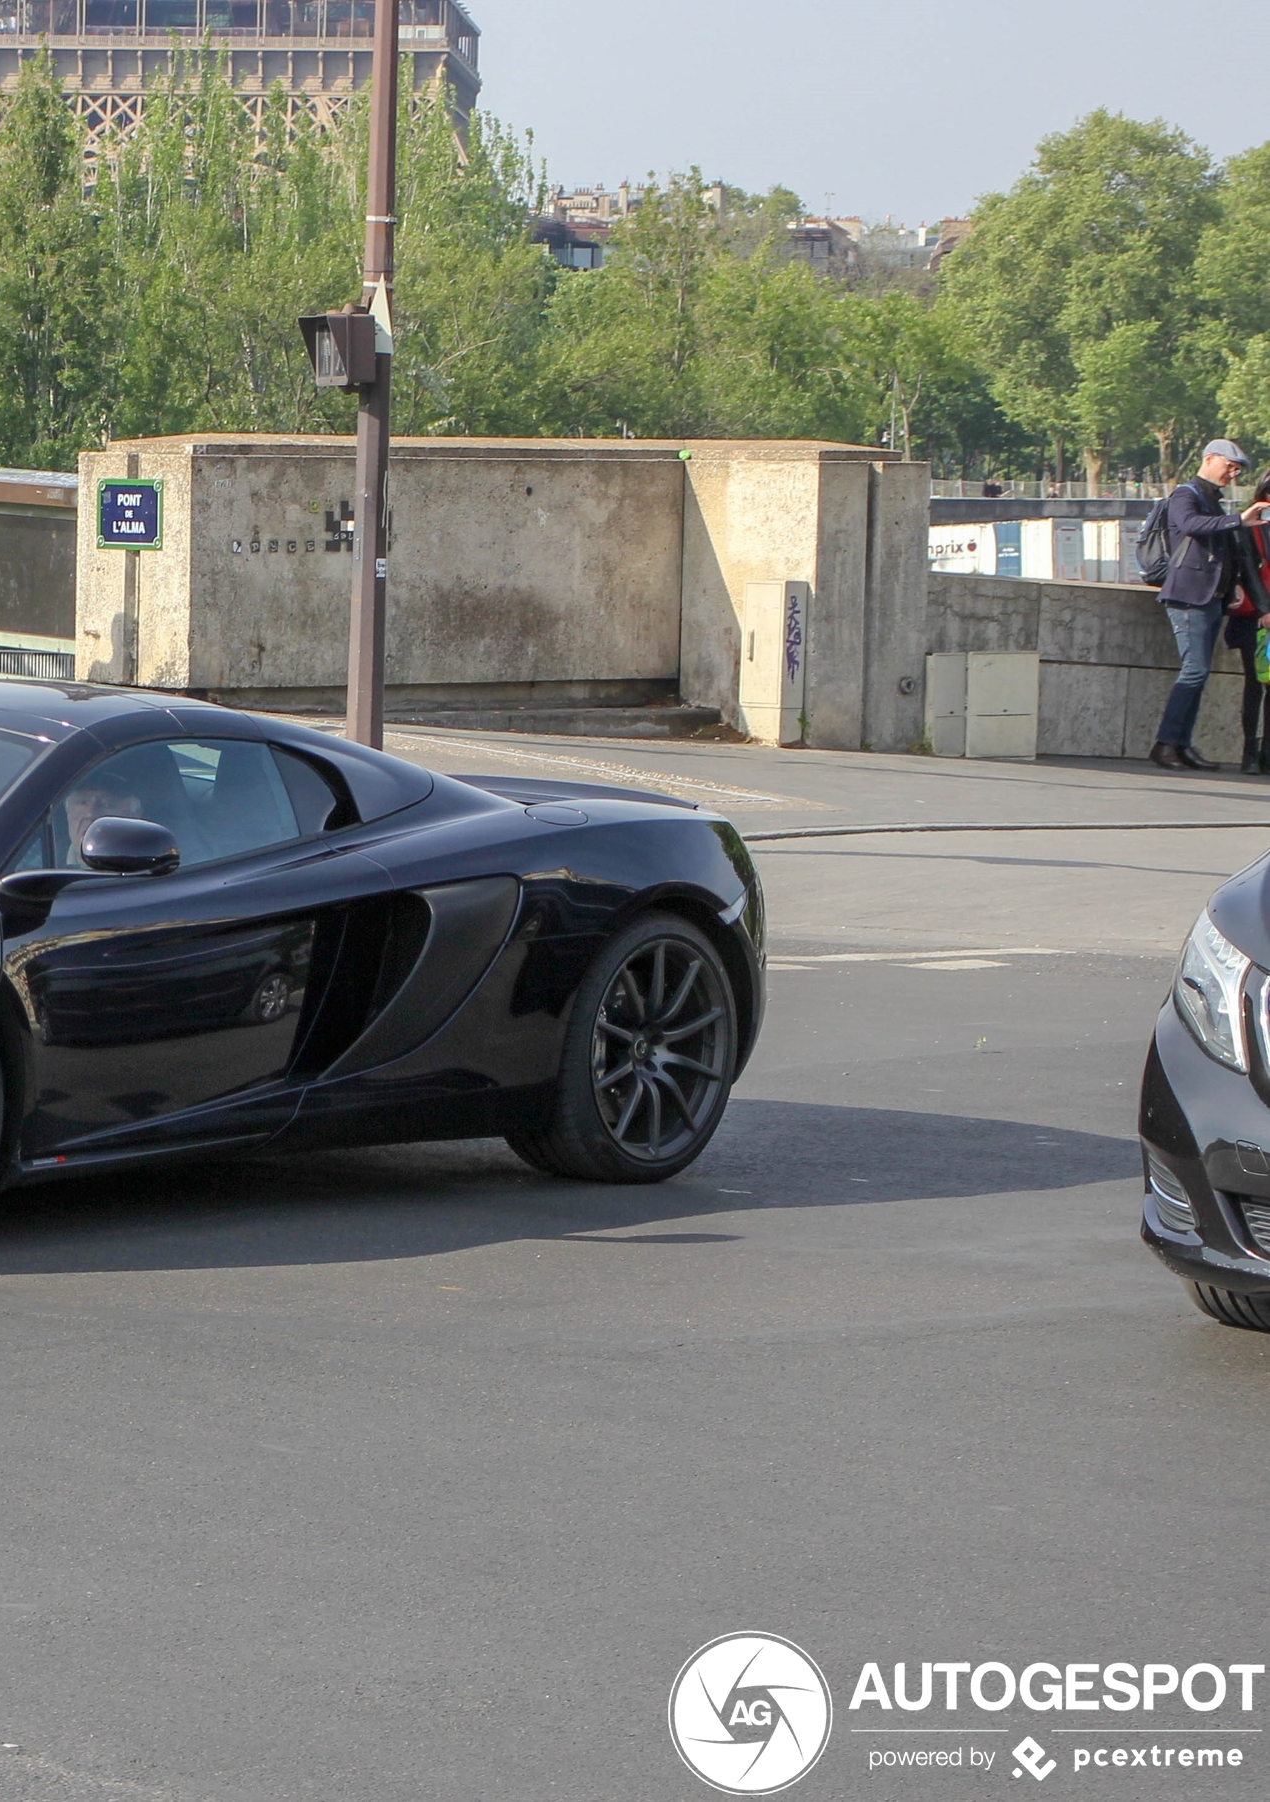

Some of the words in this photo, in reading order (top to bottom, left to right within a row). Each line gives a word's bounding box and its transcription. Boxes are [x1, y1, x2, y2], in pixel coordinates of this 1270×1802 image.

[117, 494, 142, 506] PONT
[124, 509, 134, 518] DE
[112, 520, 146, 534] L'ALMA
